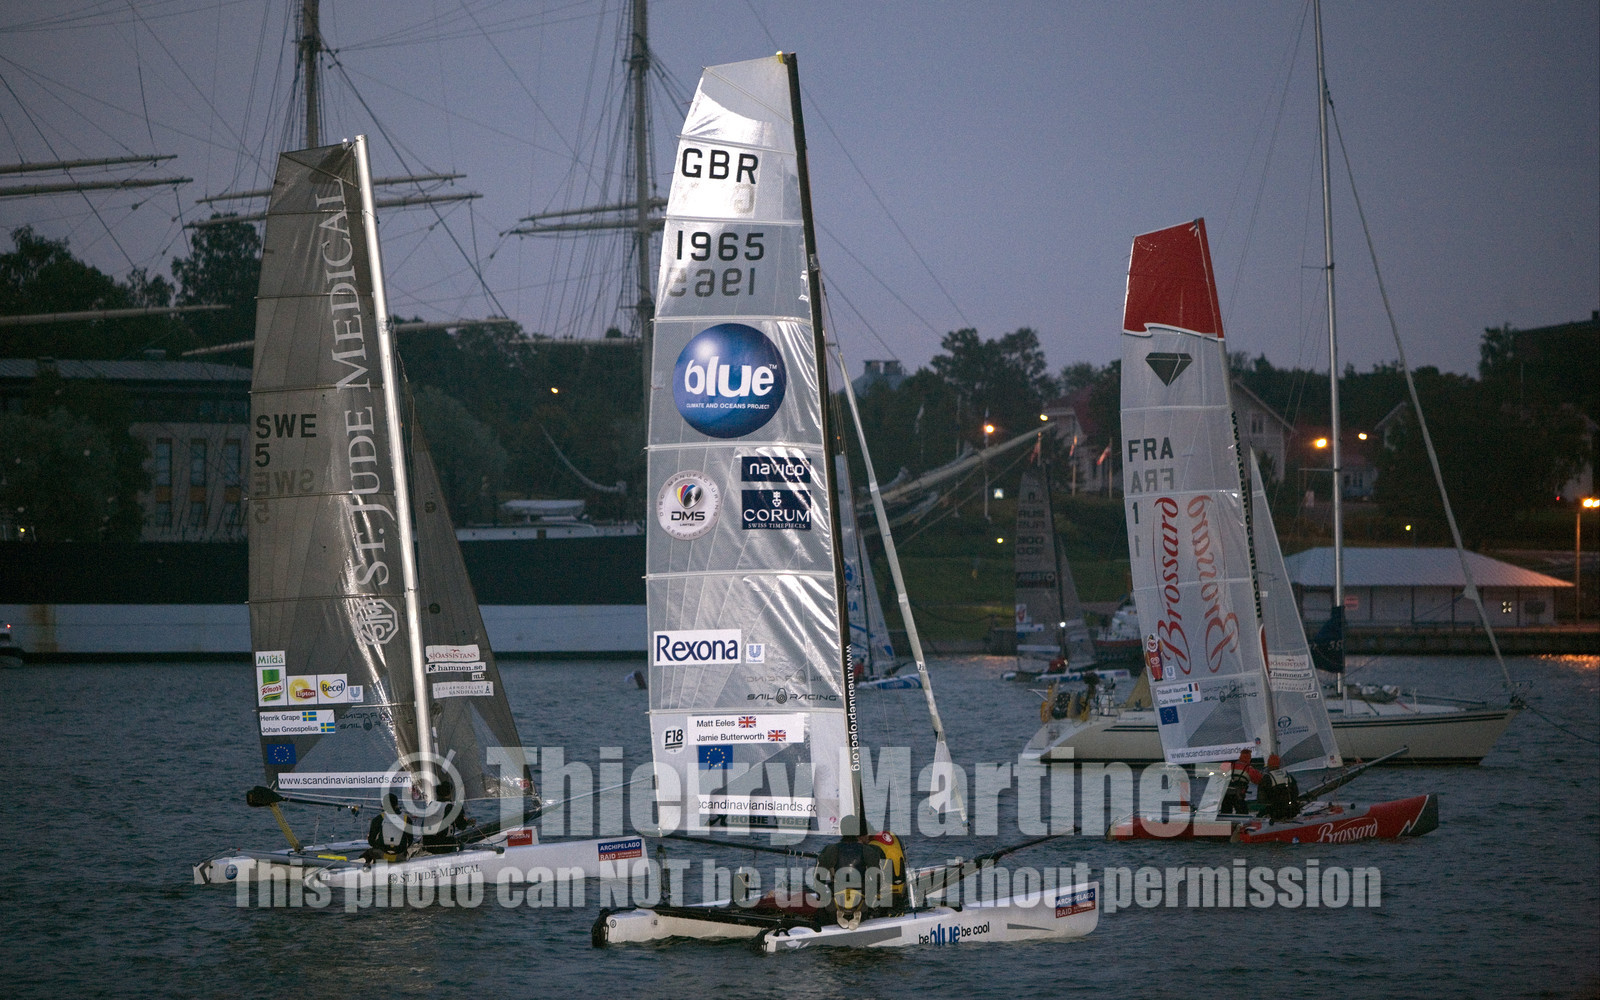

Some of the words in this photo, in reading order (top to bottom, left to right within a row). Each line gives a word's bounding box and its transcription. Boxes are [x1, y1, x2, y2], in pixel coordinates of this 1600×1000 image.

[681, 147, 759, 184] GBR
[676, 230, 764, 262] 1965
[315, 178, 371, 394] MEDICAL
[684, 356, 775, 398] blue
[256, 413, 317, 439] SWE
[255, 443, 271, 468] 5
[1128, 437, 1174, 462] FRA
[344, 406, 395, 521] JUDE
[749, 461, 805, 477] navico
[671, 510, 706, 521] DMS
[743, 508, 810, 523] CORUM
[1132, 502, 1139, 524] 1
[353, 528, 390, 586] ST.
[1154, 497, 1191, 675] Brossard
[656, 634, 739, 662] Rexona
[257, 654, 284, 665] Milda
[437, 664, 483, 672] hamnen.se
[296, 690, 316, 698] Lipton
[321, 682, 343, 692] Becel
[747, 693, 774, 701] SAIL
[789, 693, 837, 702] RACING
[281, 714, 301, 723] Grape
[696, 719, 714, 727] Matt
[715, 719, 736, 727] Eeles
[665, 728, 684, 744] F18
[696, 734, 719, 742] Jamie
[720, 732, 765, 741] Butterworth
[1170, 745, 1257, 759] www.scandinavianislandscom
[279, 774, 412, 786] www.scandinavianislands.com
[731, 815, 769, 825] HOBIE
[774, 816, 811, 826] TIGER
[1317, 817, 1378, 843] Brossard
[600, 842, 641, 851] ARCHIPELAGO
[413, 869, 437, 885] JUDE
[439, 863, 482, 878] MEDICAL
[1056, 891, 1094, 906] ARCHIPELAGO
[1056, 907, 1073, 917] RAID
[960, 926, 972, 938] be
[972, 920, 990, 935] cool
